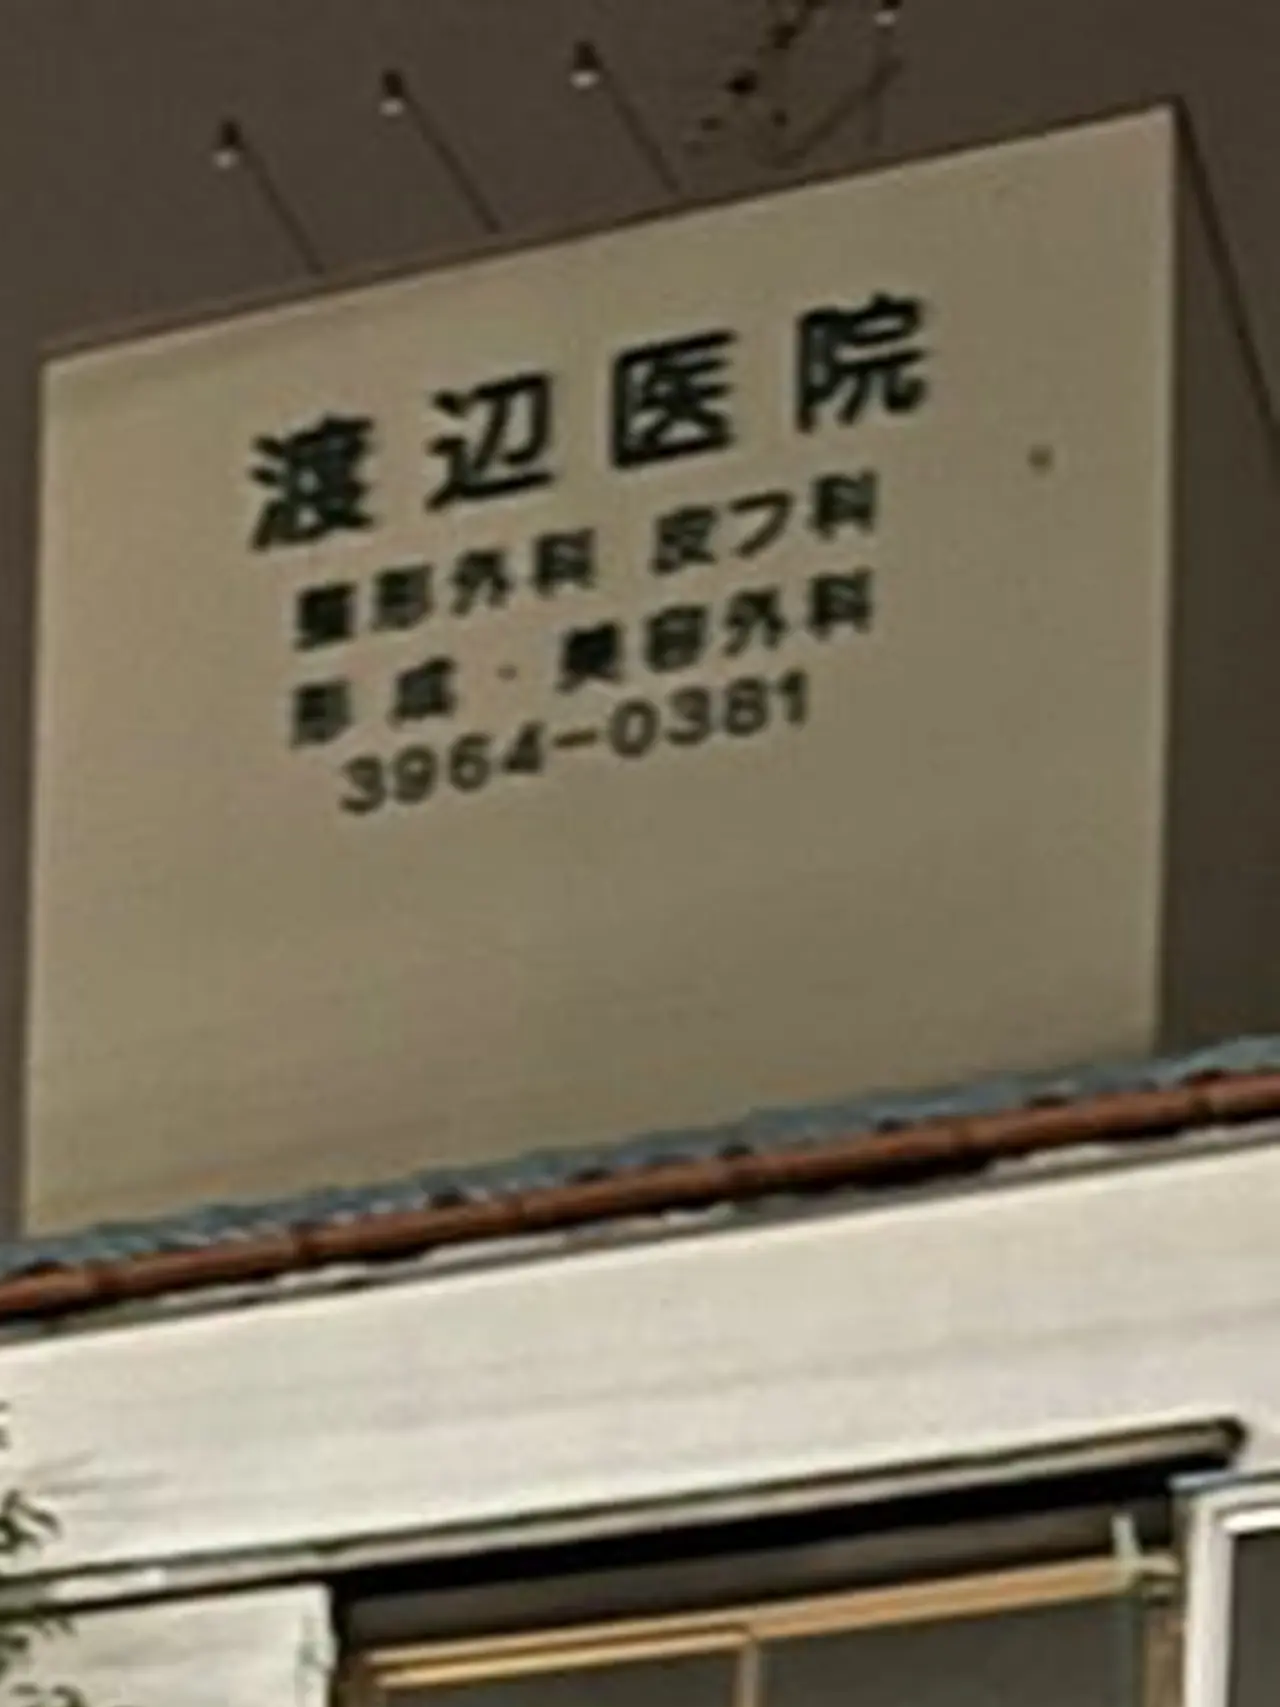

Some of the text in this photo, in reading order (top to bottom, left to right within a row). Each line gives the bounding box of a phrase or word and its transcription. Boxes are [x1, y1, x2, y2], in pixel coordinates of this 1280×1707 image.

[248, 293, 929, 551] 渡辺医院
[341, 668, 809, 815] 3964-0381
